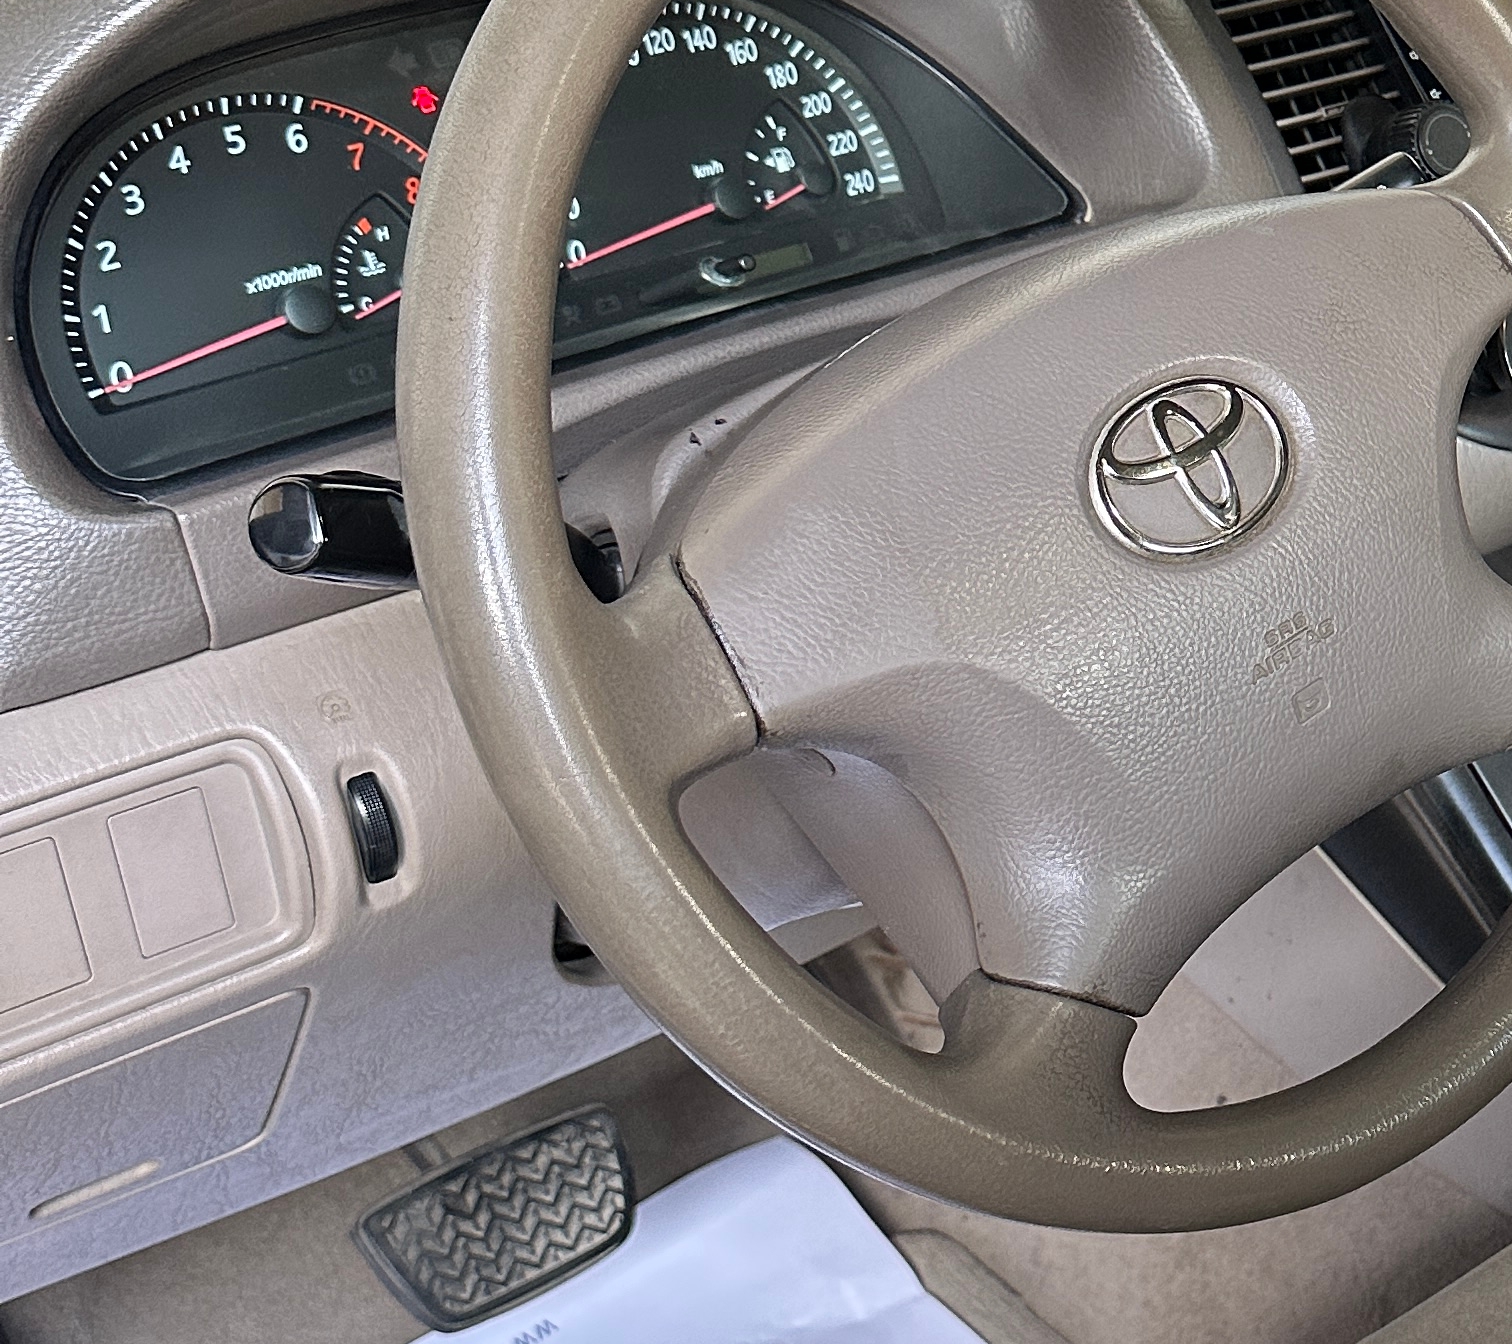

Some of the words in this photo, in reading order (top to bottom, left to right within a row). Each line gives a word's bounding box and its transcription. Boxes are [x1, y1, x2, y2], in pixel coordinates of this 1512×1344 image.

[642, 26, 676, 56] 120
[680, 23, 717, 54] 140
[723, 36, 759, 67] 160
[762, 60, 799, 90] 180
[800, 90, 833, 119] 200
[826, 128, 859, 157] 220
[843, 168, 876, 196] 240
[222, 124, 247, 155] 5
[285, 123, 309, 154] 6
[168, 145, 192, 175] 4
[346, 142, 364, 171] 7
[691, 159, 725, 178] km/h
[120, 184, 145, 216] 3
[95, 240, 122, 272] 2
[91, 305, 112, 334] 1
[109, 360, 135, 393] 0
